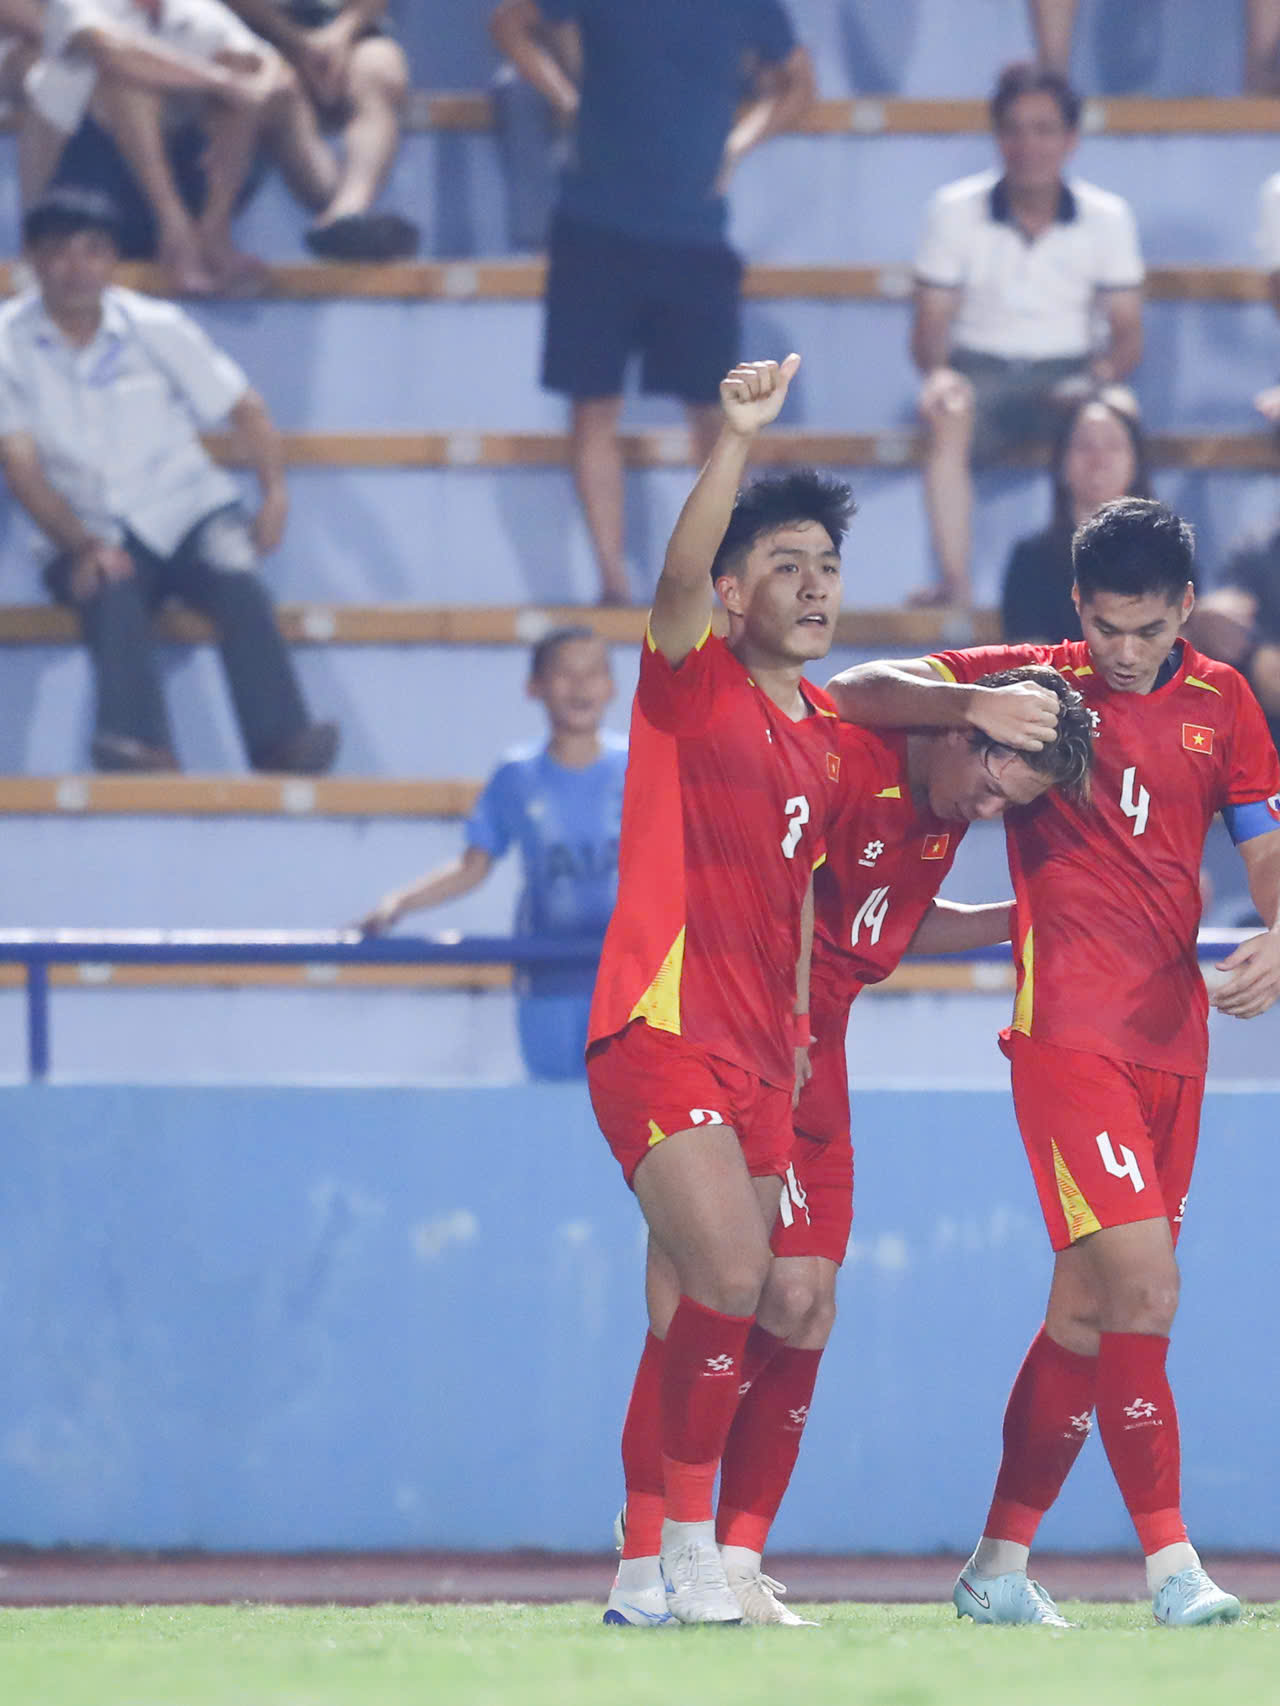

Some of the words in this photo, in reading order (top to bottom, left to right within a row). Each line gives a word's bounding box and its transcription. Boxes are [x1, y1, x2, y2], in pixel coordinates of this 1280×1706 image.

[781, 795, 810, 859] 3
[1120, 766, 1150, 836] 4
[851, 885, 890, 947] 14
[1096, 1131, 1145, 1193] 4
